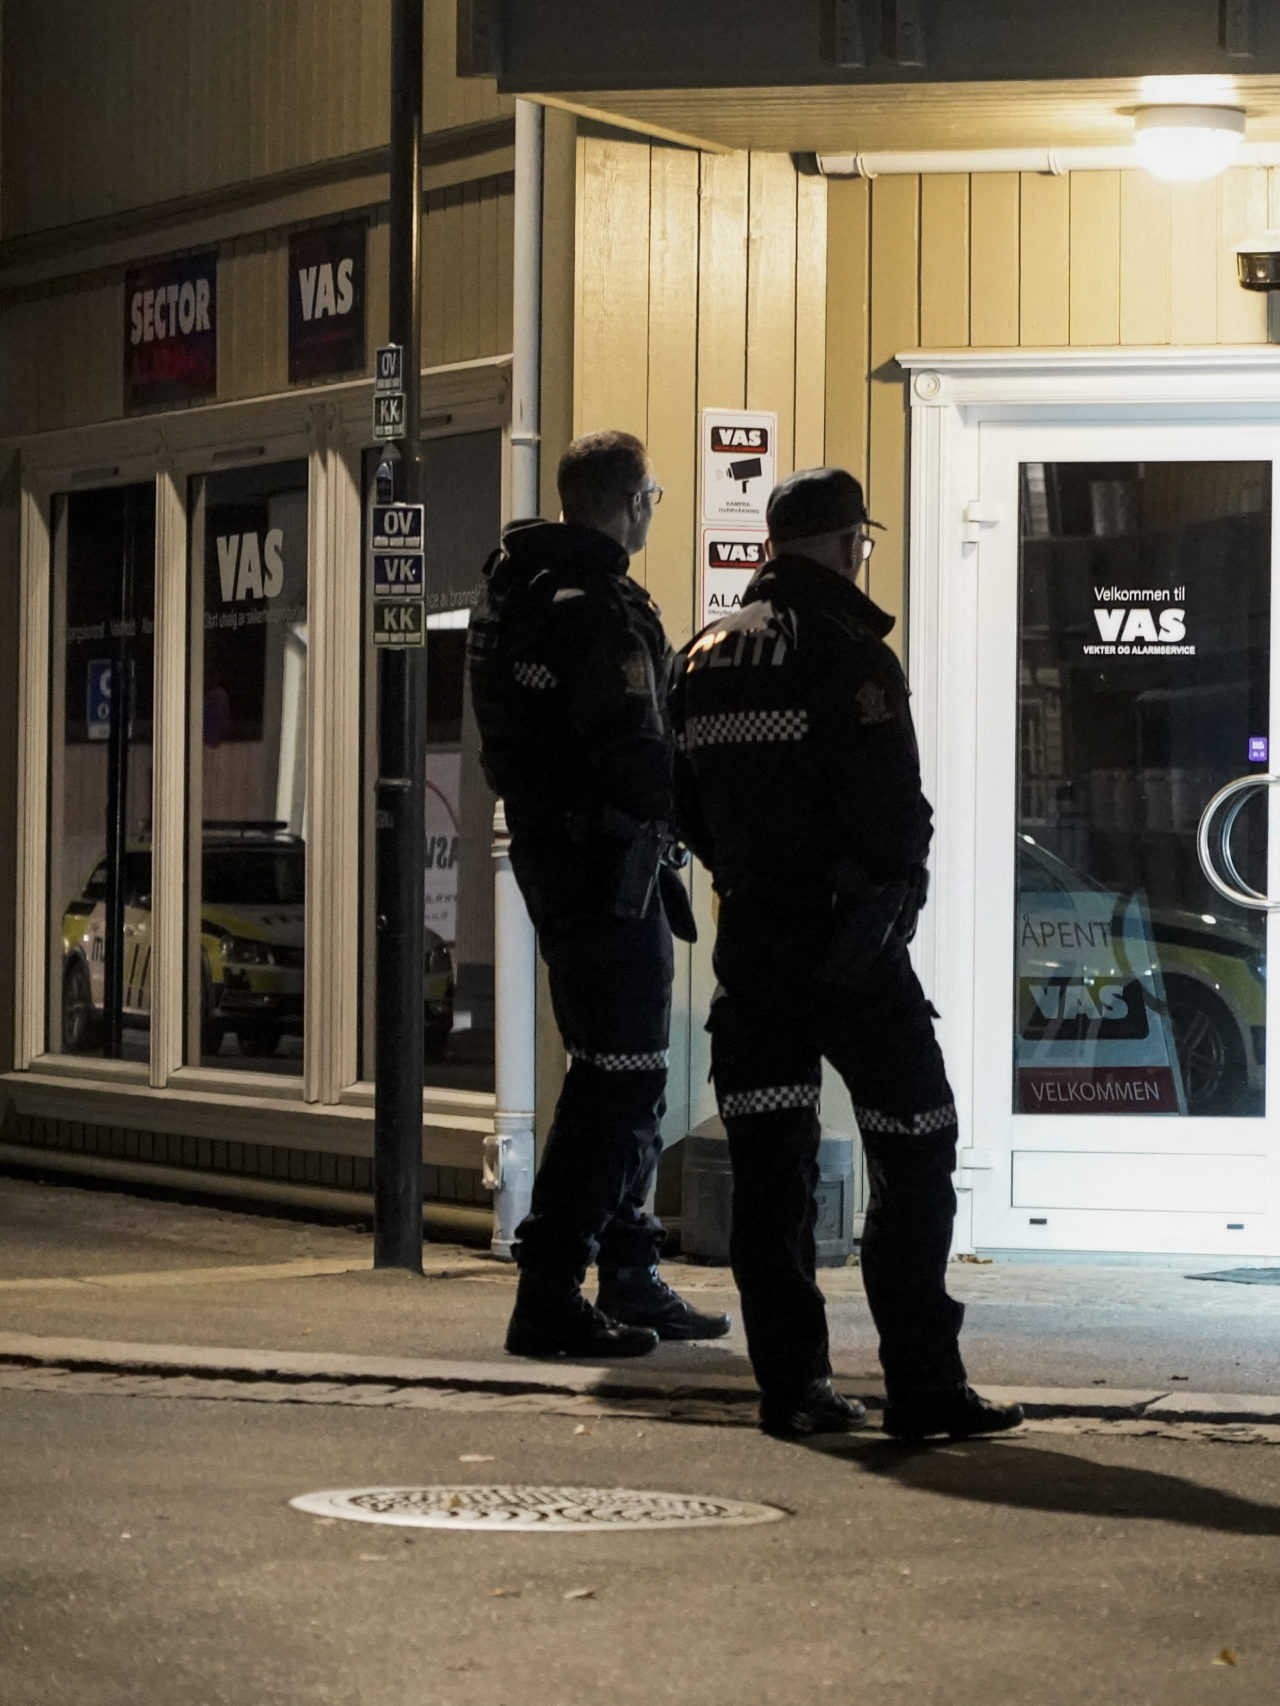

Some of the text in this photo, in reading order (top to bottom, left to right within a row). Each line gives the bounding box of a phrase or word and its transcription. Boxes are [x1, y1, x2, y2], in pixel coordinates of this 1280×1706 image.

[298, 258, 354, 321] VAS
[130, 277, 211, 345] SECTOR
[381, 352, 397, 377] OV
[380, 399, 400, 423] KK
[718, 428, 762, 447] VAS
[383, 510, 413, 535] OV
[216, 528, 284, 602] VAS
[716, 543, 760, 562] VAS
[384, 558, 414, 583] VK
[709, 593, 742, 607] ALA
[1094, 585, 1186, 601] Velkommen til
[383, 607, 415, 631] KK
[1093, 608, 1186, 642] VAS
[1083, 645, 1196, 655] VEKTER OG ALARMSERVICE
[1021, 916, 1112, 948] ÅPENT
[1028, 984, 1129, 1020] VAS
[1031, 1081, 1160, 1102] VELKOMMEN
